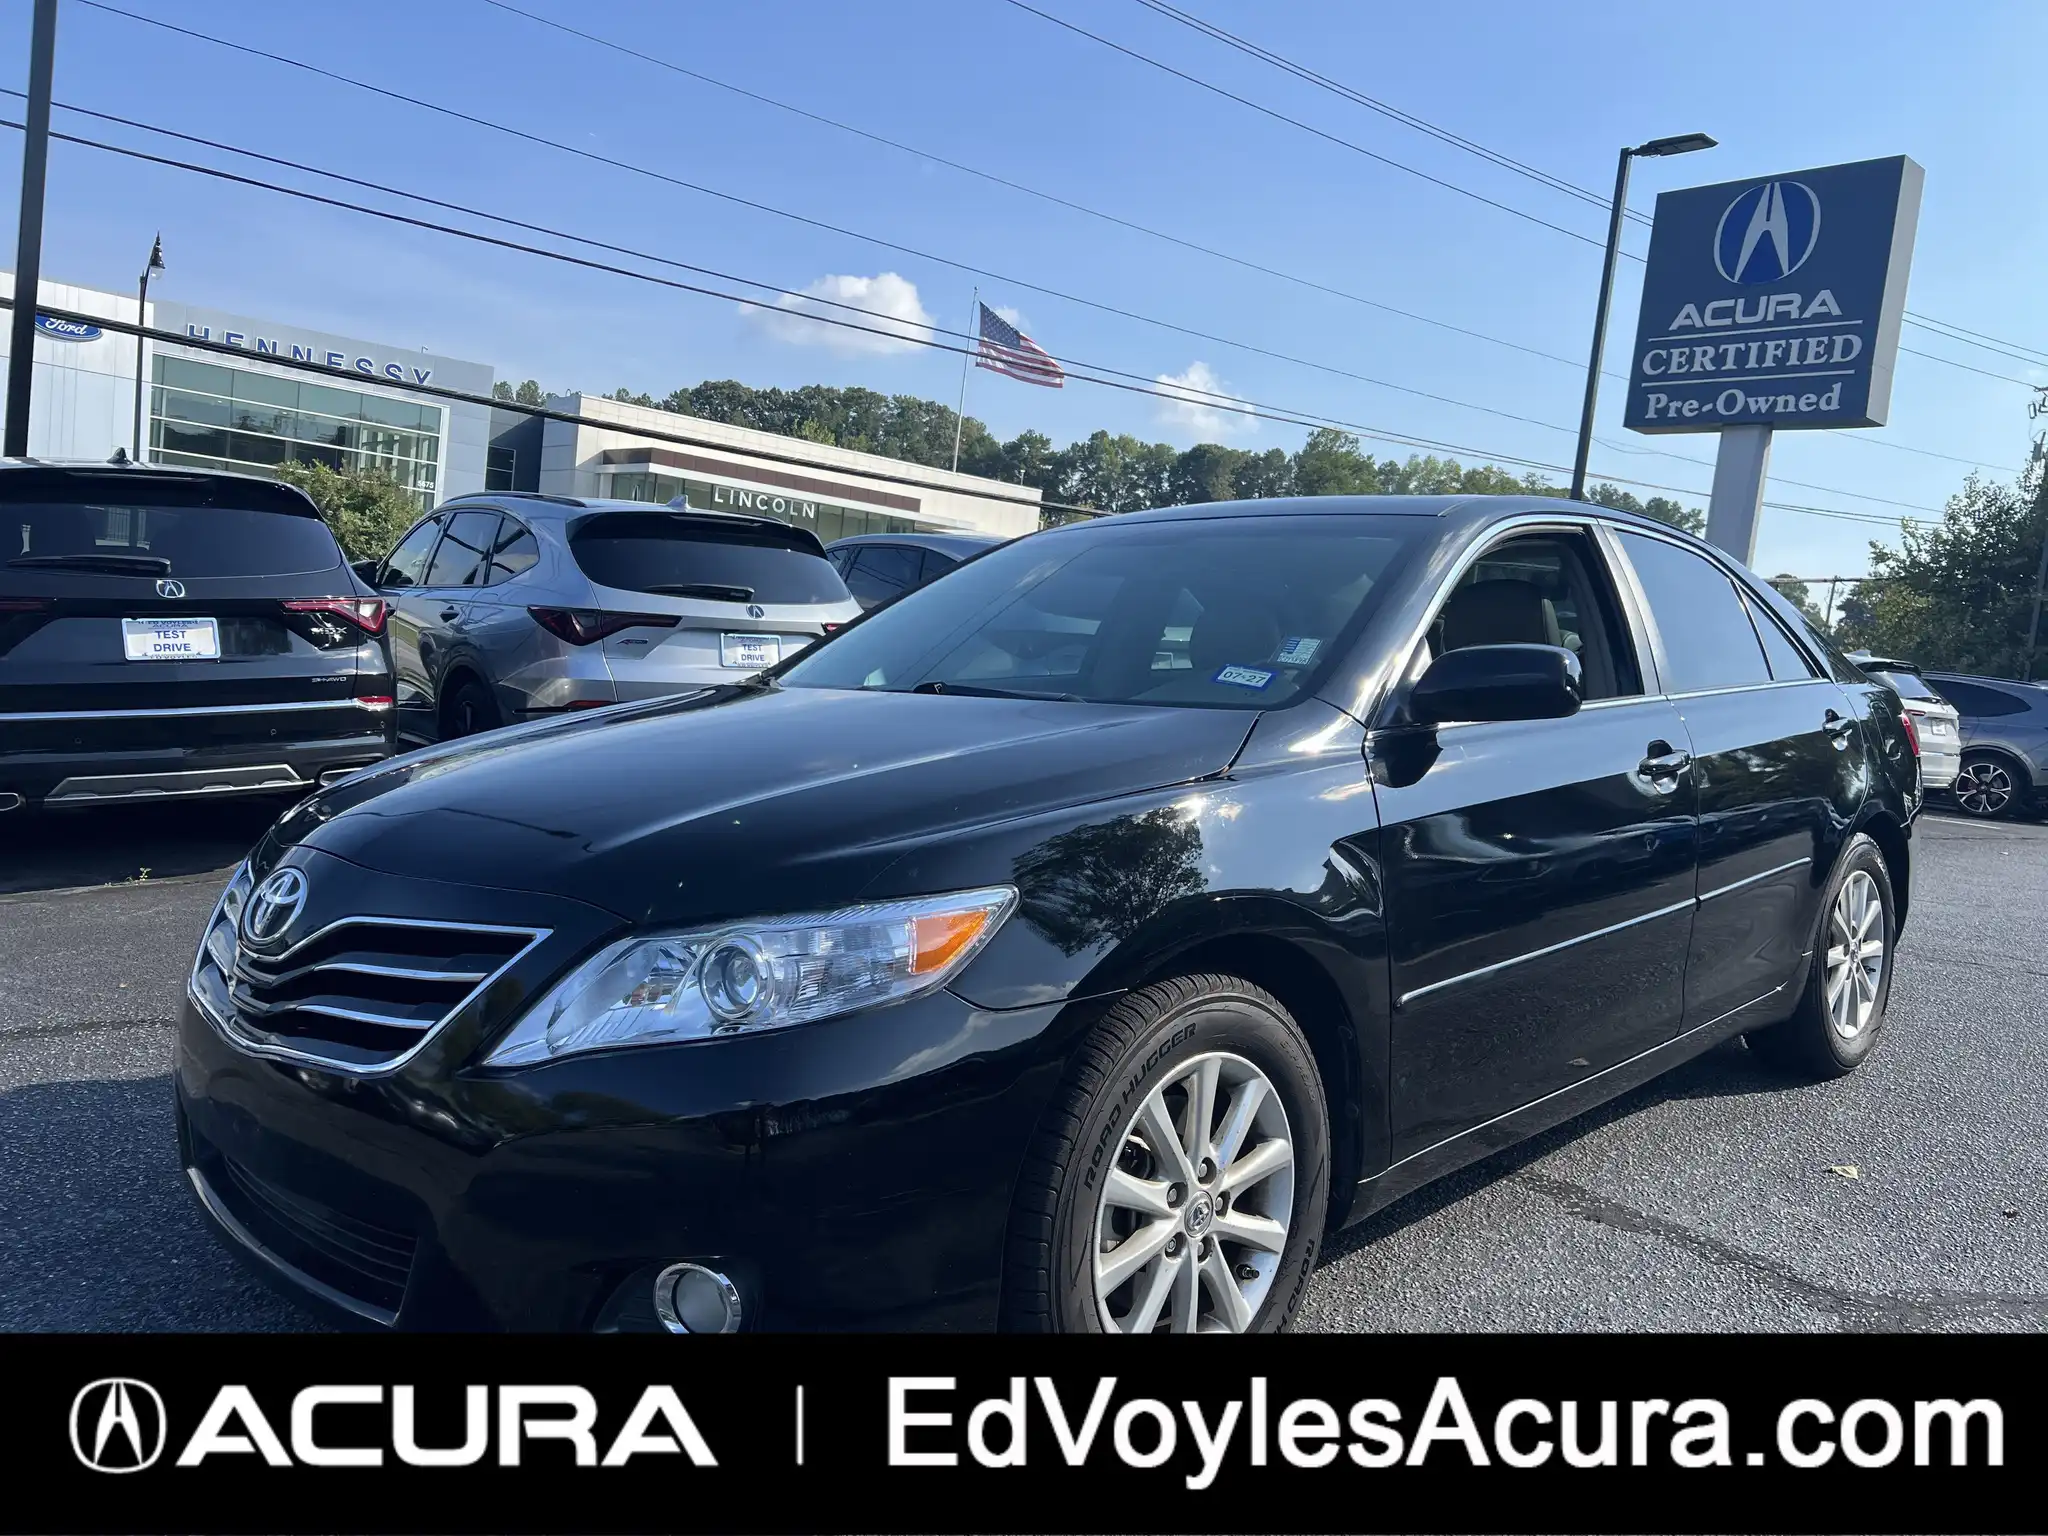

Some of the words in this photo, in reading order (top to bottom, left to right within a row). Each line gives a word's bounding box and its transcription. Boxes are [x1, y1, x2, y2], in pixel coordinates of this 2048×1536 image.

[1668, 289, 1843, 331] ACURA
[45, 317, 88, 335] Ford
[186, 324, 431, 386] HENNESSY
[1642, 334, 1863, 376] CERTIFIED
[1645, 382, 1842, 419] Pre-Owned
[714, 487, 815, 518] LINCOLN
[153, 643, 192, 653] DRIVE
[155, 630, 186, 640] TEST
[742, 643, 763, 652] TEST
[741, 654, 765, 662] DRIVE
[1083, 1103, 1122, 1191] ROAD
[1122, 1022, 1197, 1104] HUGGER
